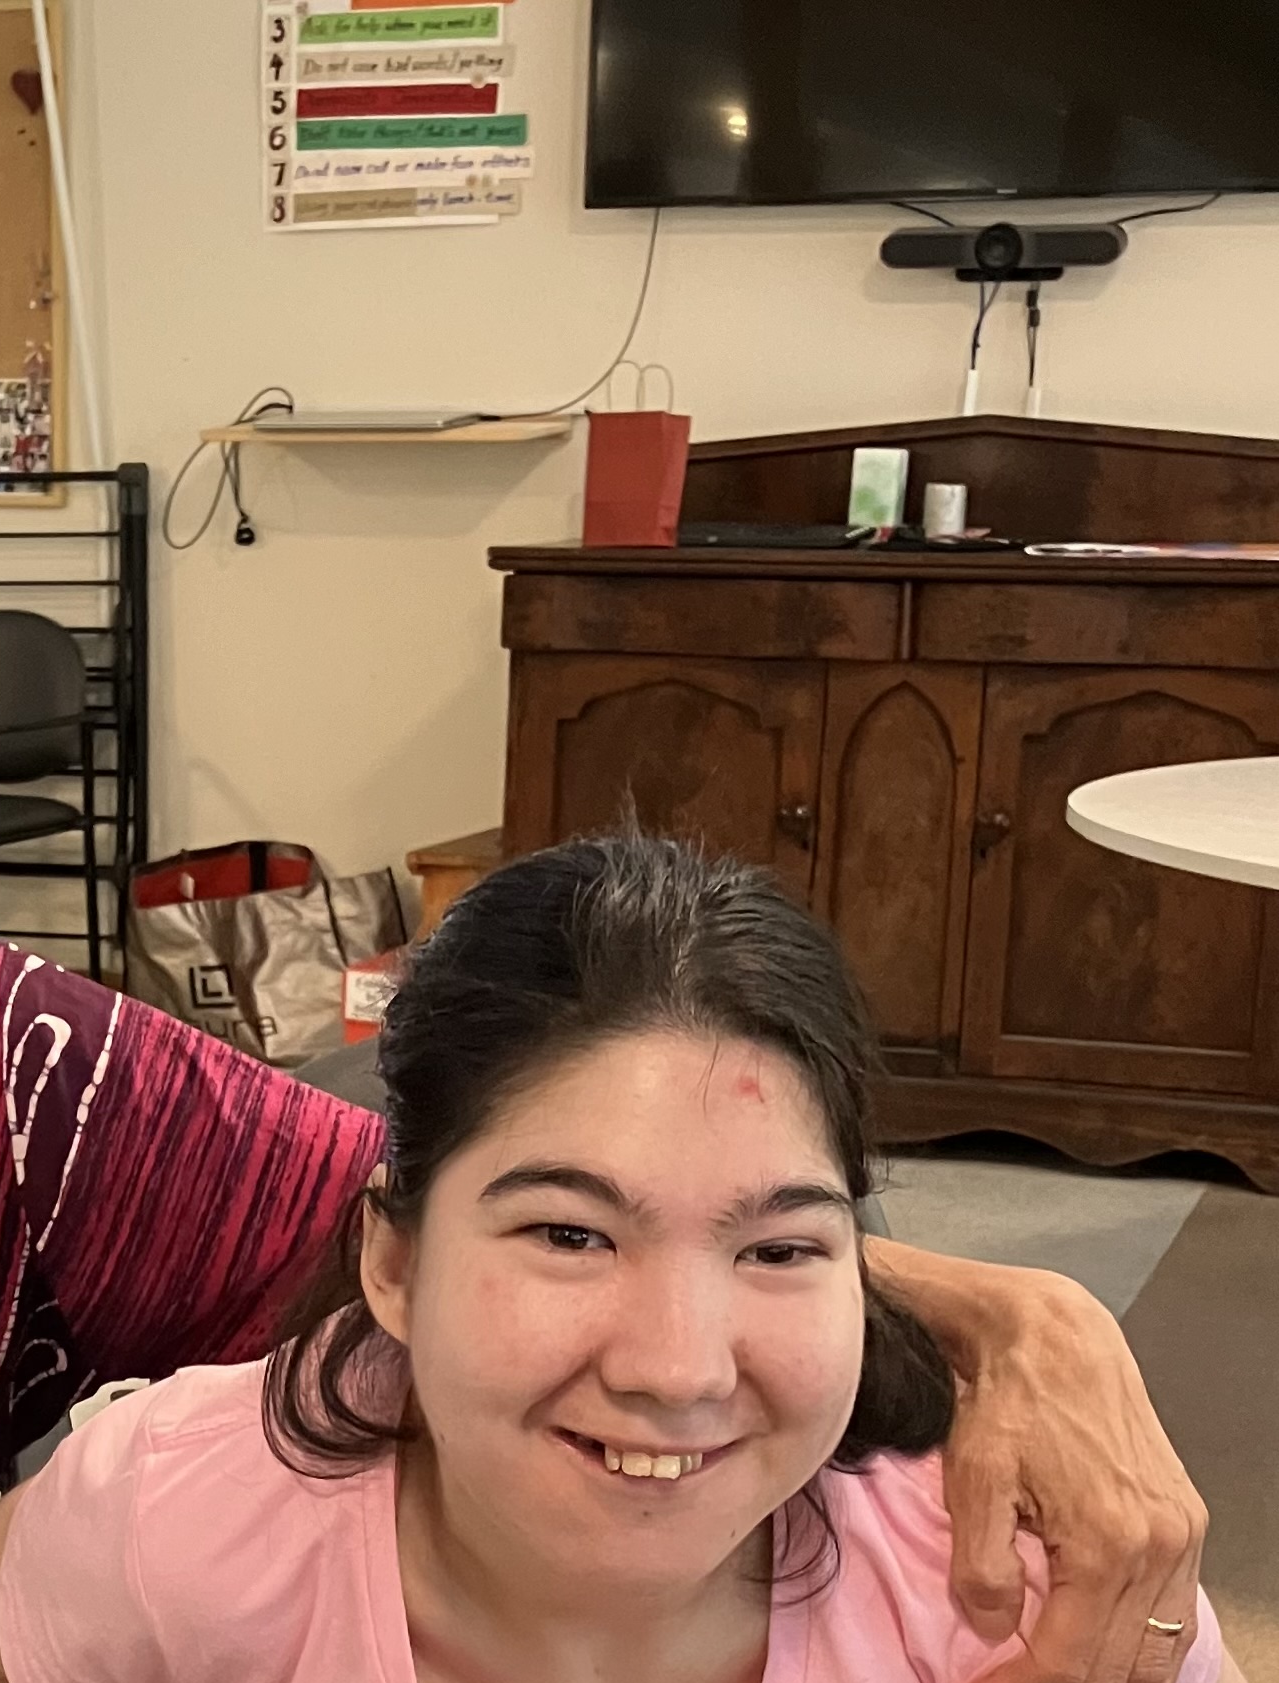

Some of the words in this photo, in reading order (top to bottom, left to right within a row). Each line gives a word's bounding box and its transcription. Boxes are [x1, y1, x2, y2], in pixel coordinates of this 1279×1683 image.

[270, 17, 286, 43] 3
[269, 53, 284, 81] 4
[270, 90, 287, 115] 5
[269, 125, 287, 151] 6
[272, 162, 286, 187] 7
[270, 195, 286, 223] 8
